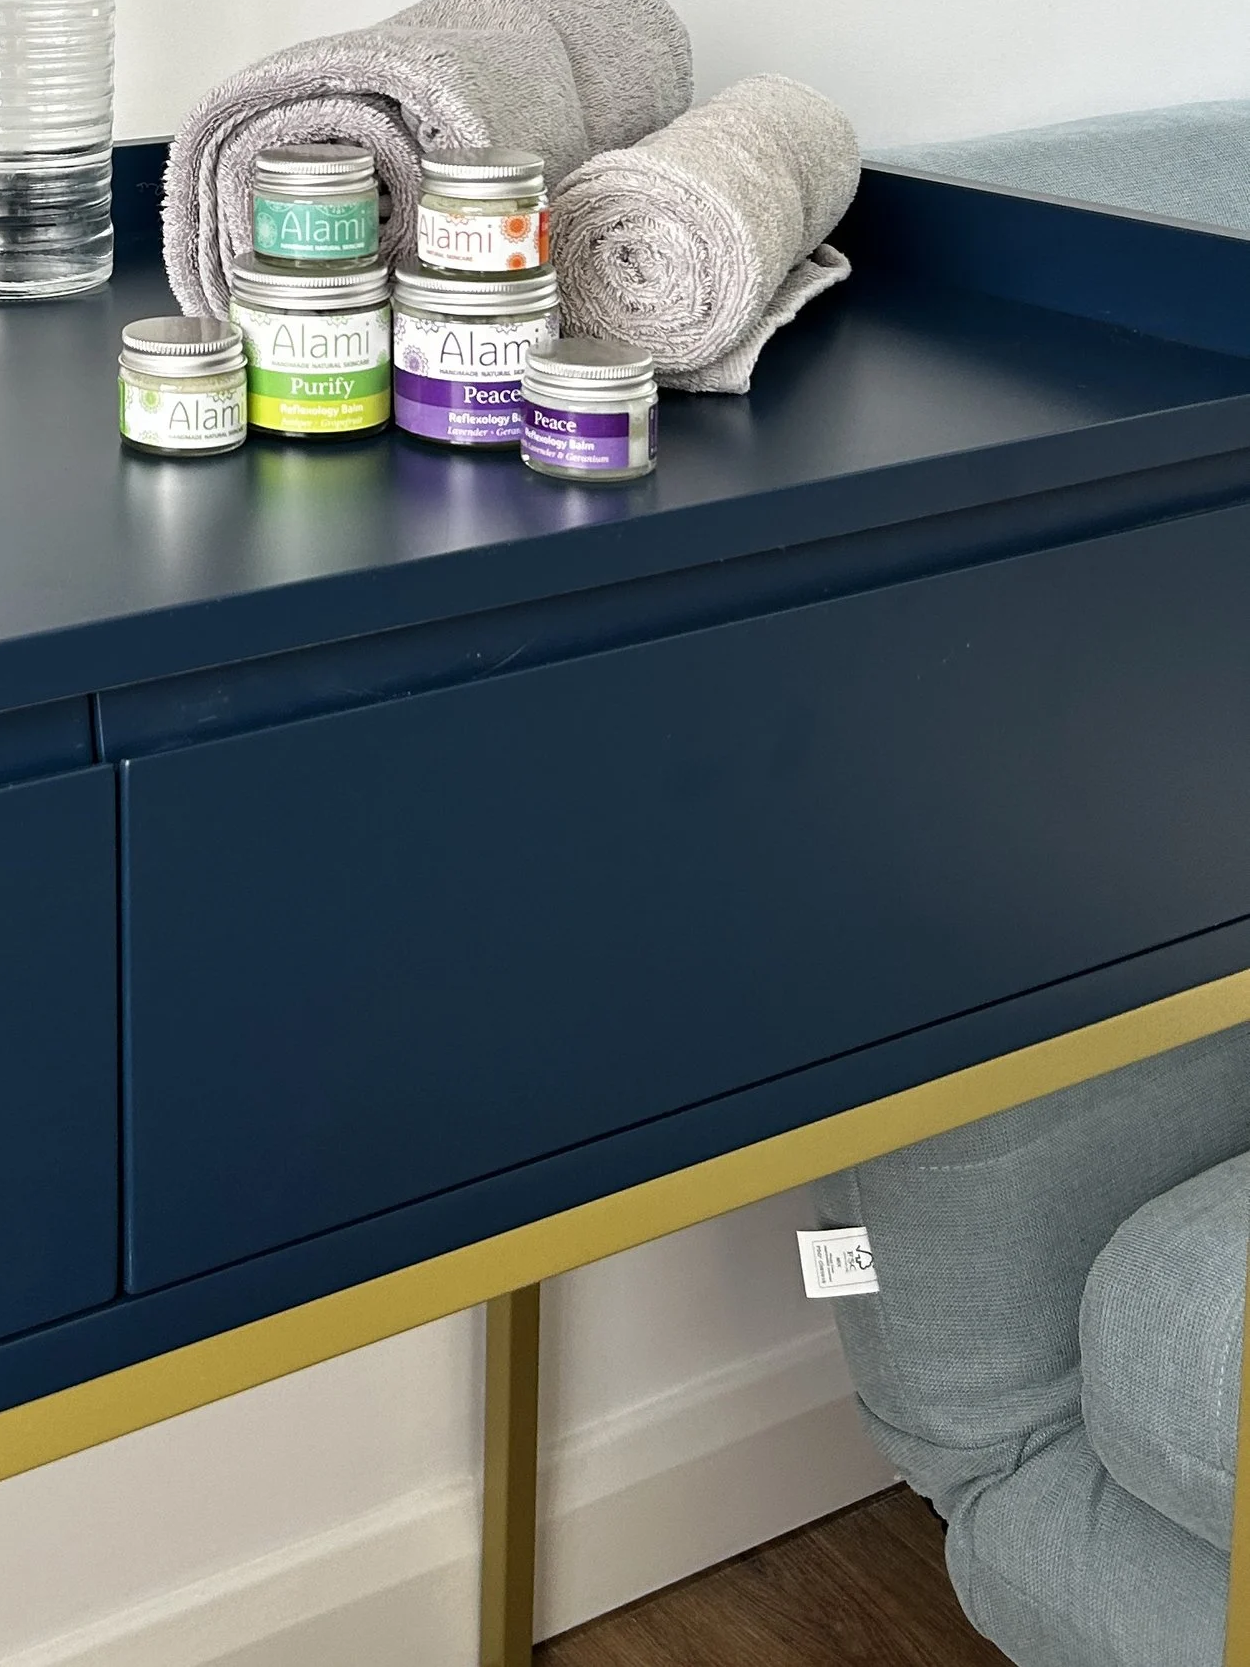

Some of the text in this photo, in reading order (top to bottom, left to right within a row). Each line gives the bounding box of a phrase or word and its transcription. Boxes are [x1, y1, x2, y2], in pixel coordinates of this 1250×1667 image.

[281, 210, 365, 242] Alami
[419, 214, 492, 253] Alami
[272, 322, 370, 358] Alami
[272, 359, 370, 369] HANDMADE NATURAL SKINCARE
[439, 368, 478, 377] HANDMADE
[290, 377, 355, 399] Purify
[463, 386, 521, 404] Peace
[280, 403, 364, 417] Reflexology Balm
[448, 412, 510, 426] Reflexology
[533, 410, 578, 433] Peace
[447, 426, 488, 437] Lavender
[569, 439, 595, 451] Balm
[565, 453, 610, 464] Geranium
